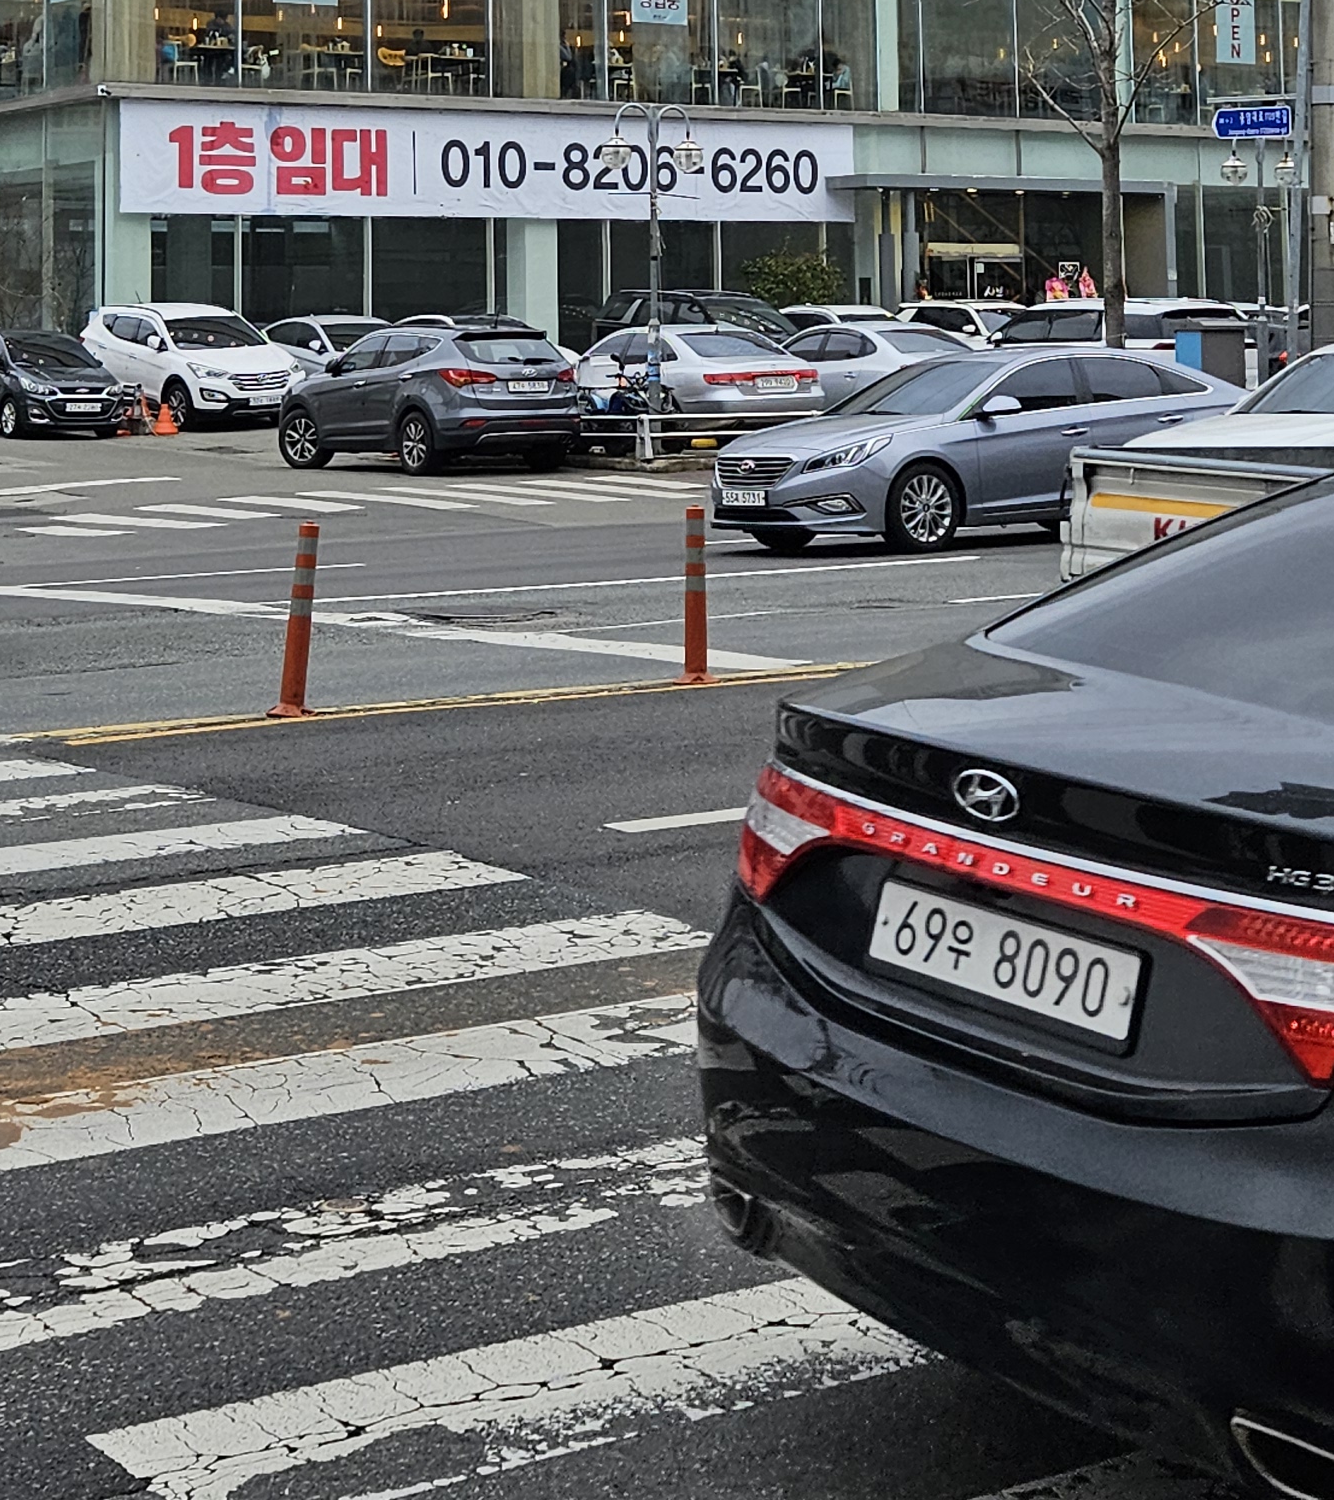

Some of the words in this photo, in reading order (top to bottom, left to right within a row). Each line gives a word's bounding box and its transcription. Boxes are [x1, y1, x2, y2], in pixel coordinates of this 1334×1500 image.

[440, 138, 819, 196] 010-8206-6260
[861, 821, 1137, 909] GRANDEUR
[894, 900, 975, 971] 69우
[993, 929, 1110, 1018] 8090
